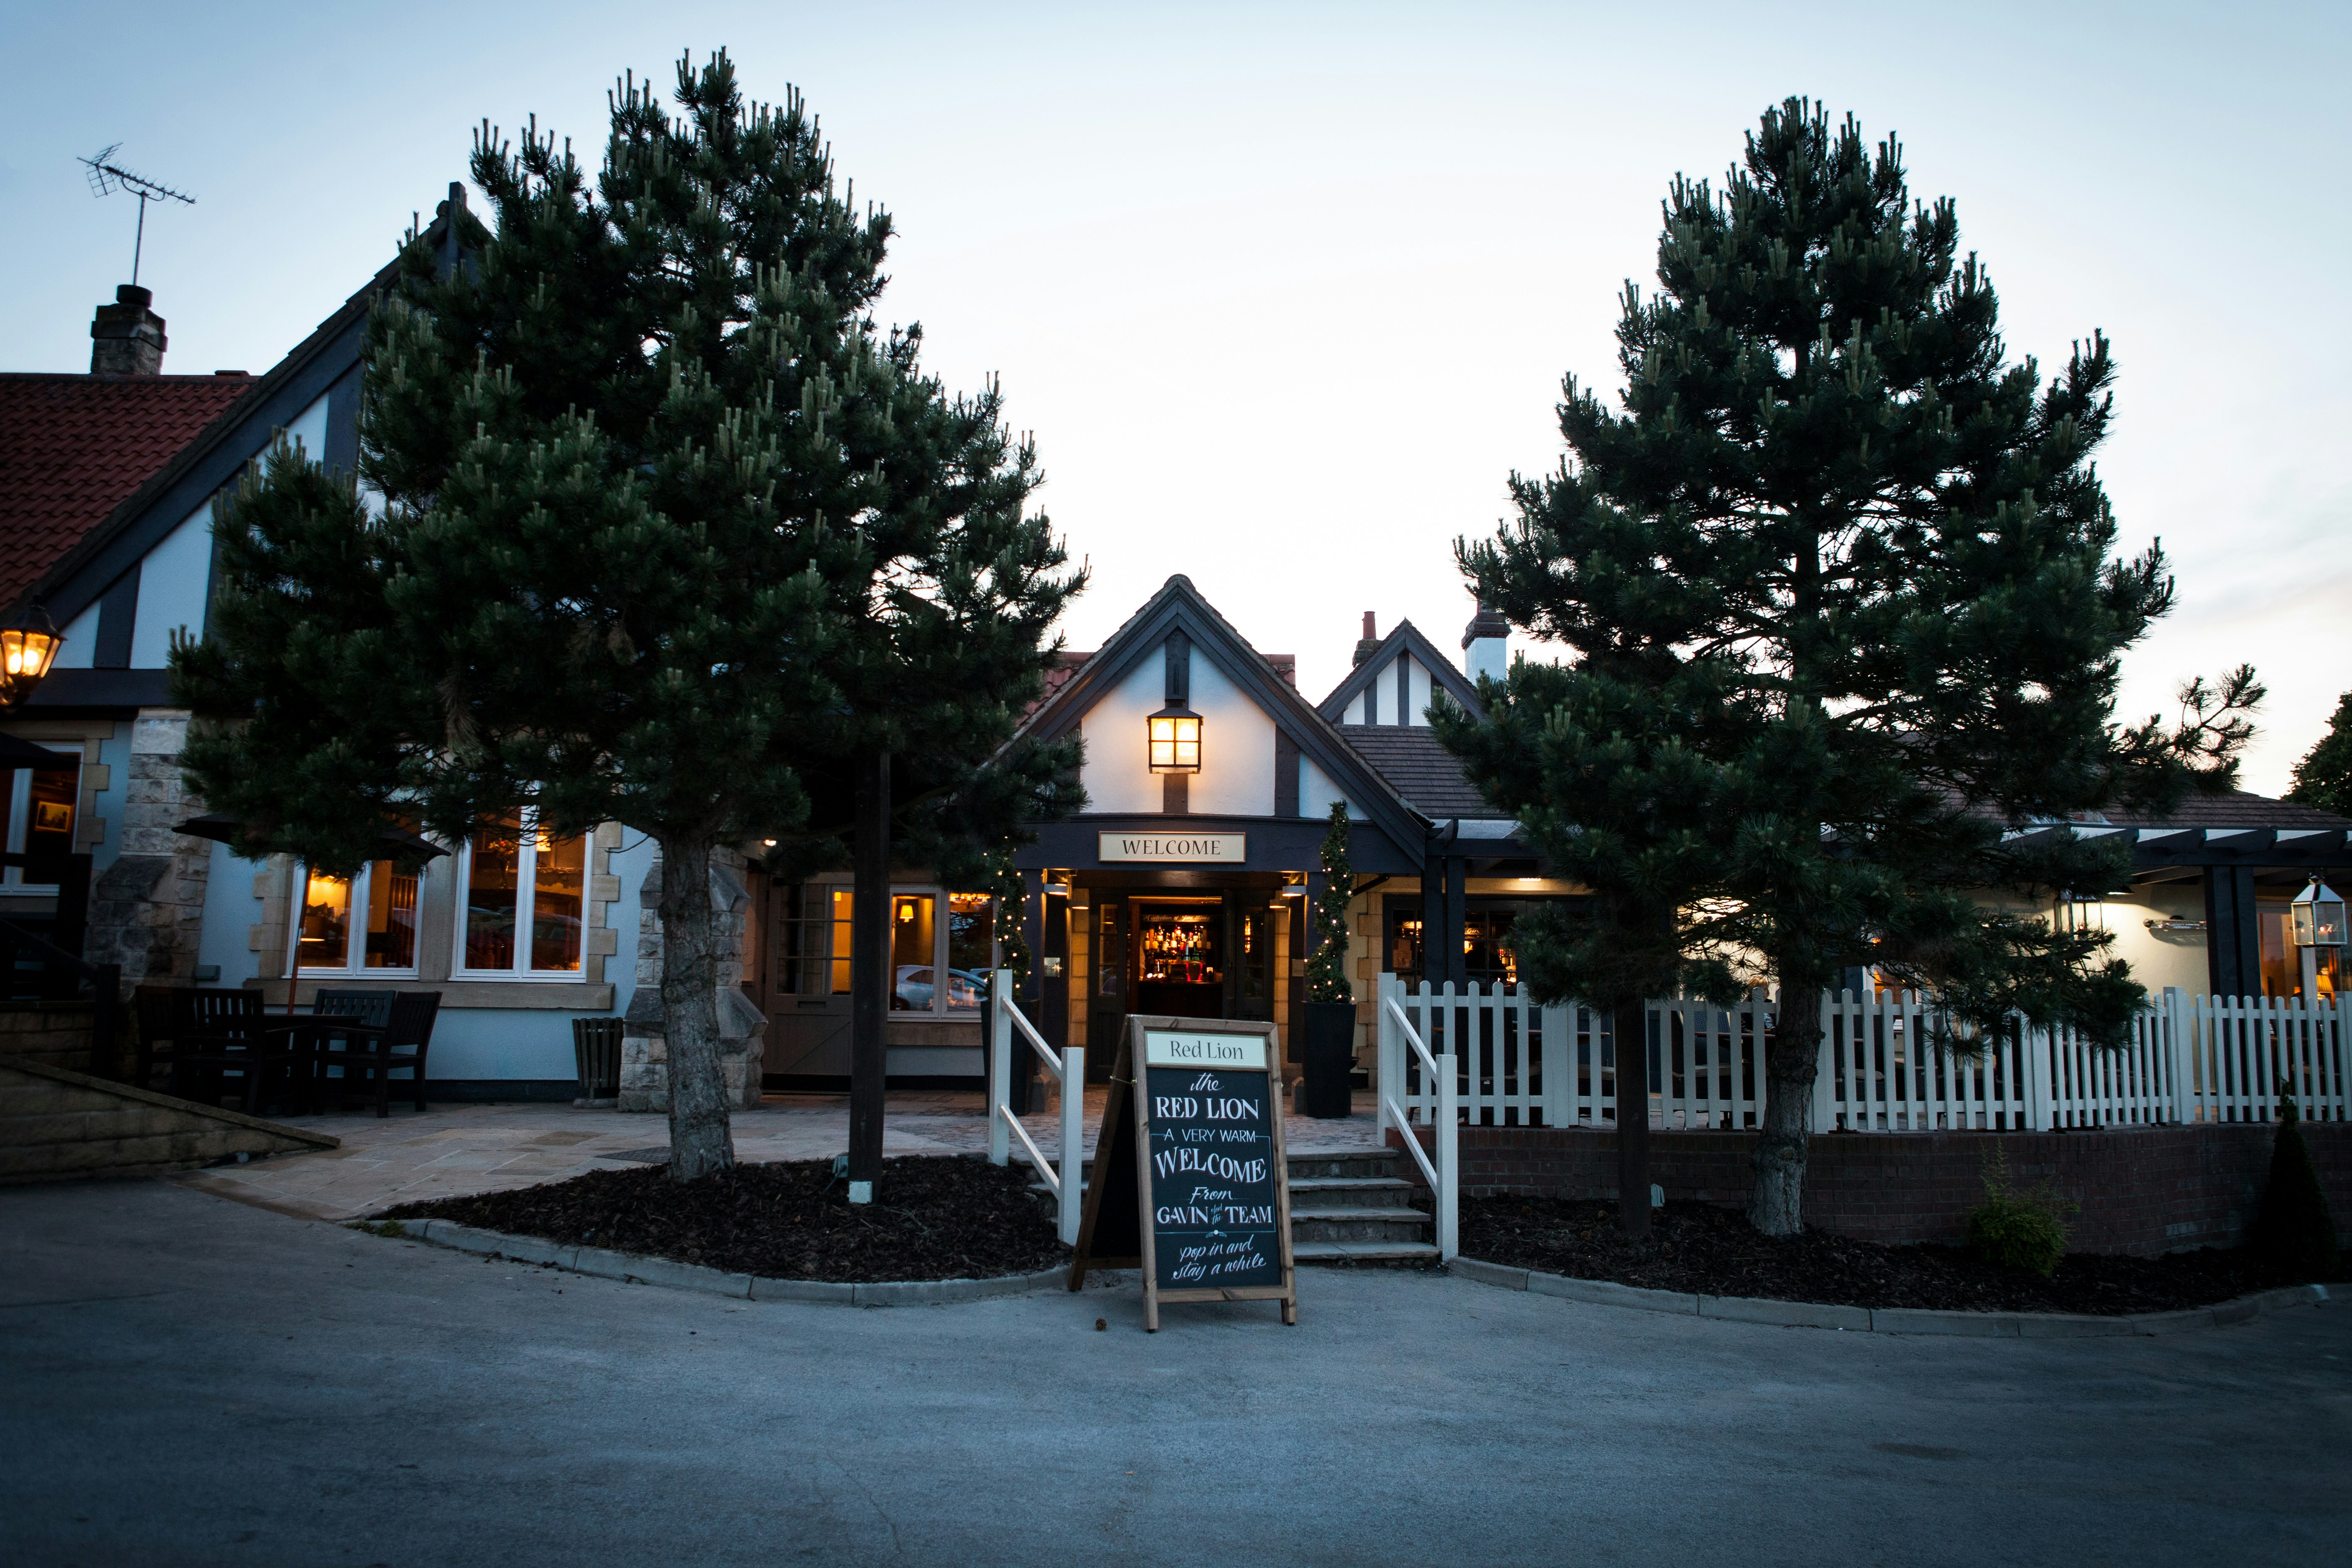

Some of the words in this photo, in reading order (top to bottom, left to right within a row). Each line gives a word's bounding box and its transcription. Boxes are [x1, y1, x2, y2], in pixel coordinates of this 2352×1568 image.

[1122, 840, 1220, 855] WELCOME
[1170, 1040, 1202, 1057] Red
[1207, 1042, 1244, 1060] Lion
[1190, 1072, 1225, 1091] the
[1155, 1096, 1198, 1118] RED
[1206, 1098, 1259, 1119] LION
[1163, 1128, 1174, 1141] A
[1182, 1129, 1215, 1142] VERY
[1220, 1130, 1256, 1142] WARM
[1154, 1146, 1266, 1183] WELCOME
[1189, 1186, 1233, 1204] From
[1157, 1206, 1209, 1224] GAVIN
[1211, 1213, 1223, 1225] the
[1225, 1206, 1272, 1223] TEAM
[1180, 1246, 1206, 1262] pop
[1208, 1242, 1223, 1256] in
[1226, 1234, 1254, 1254] and
[1171, 1261, 1207, 1281] stay
[1211, 1263, 1221, 1275] a
[1225, 1253, 1267, 1271] while
